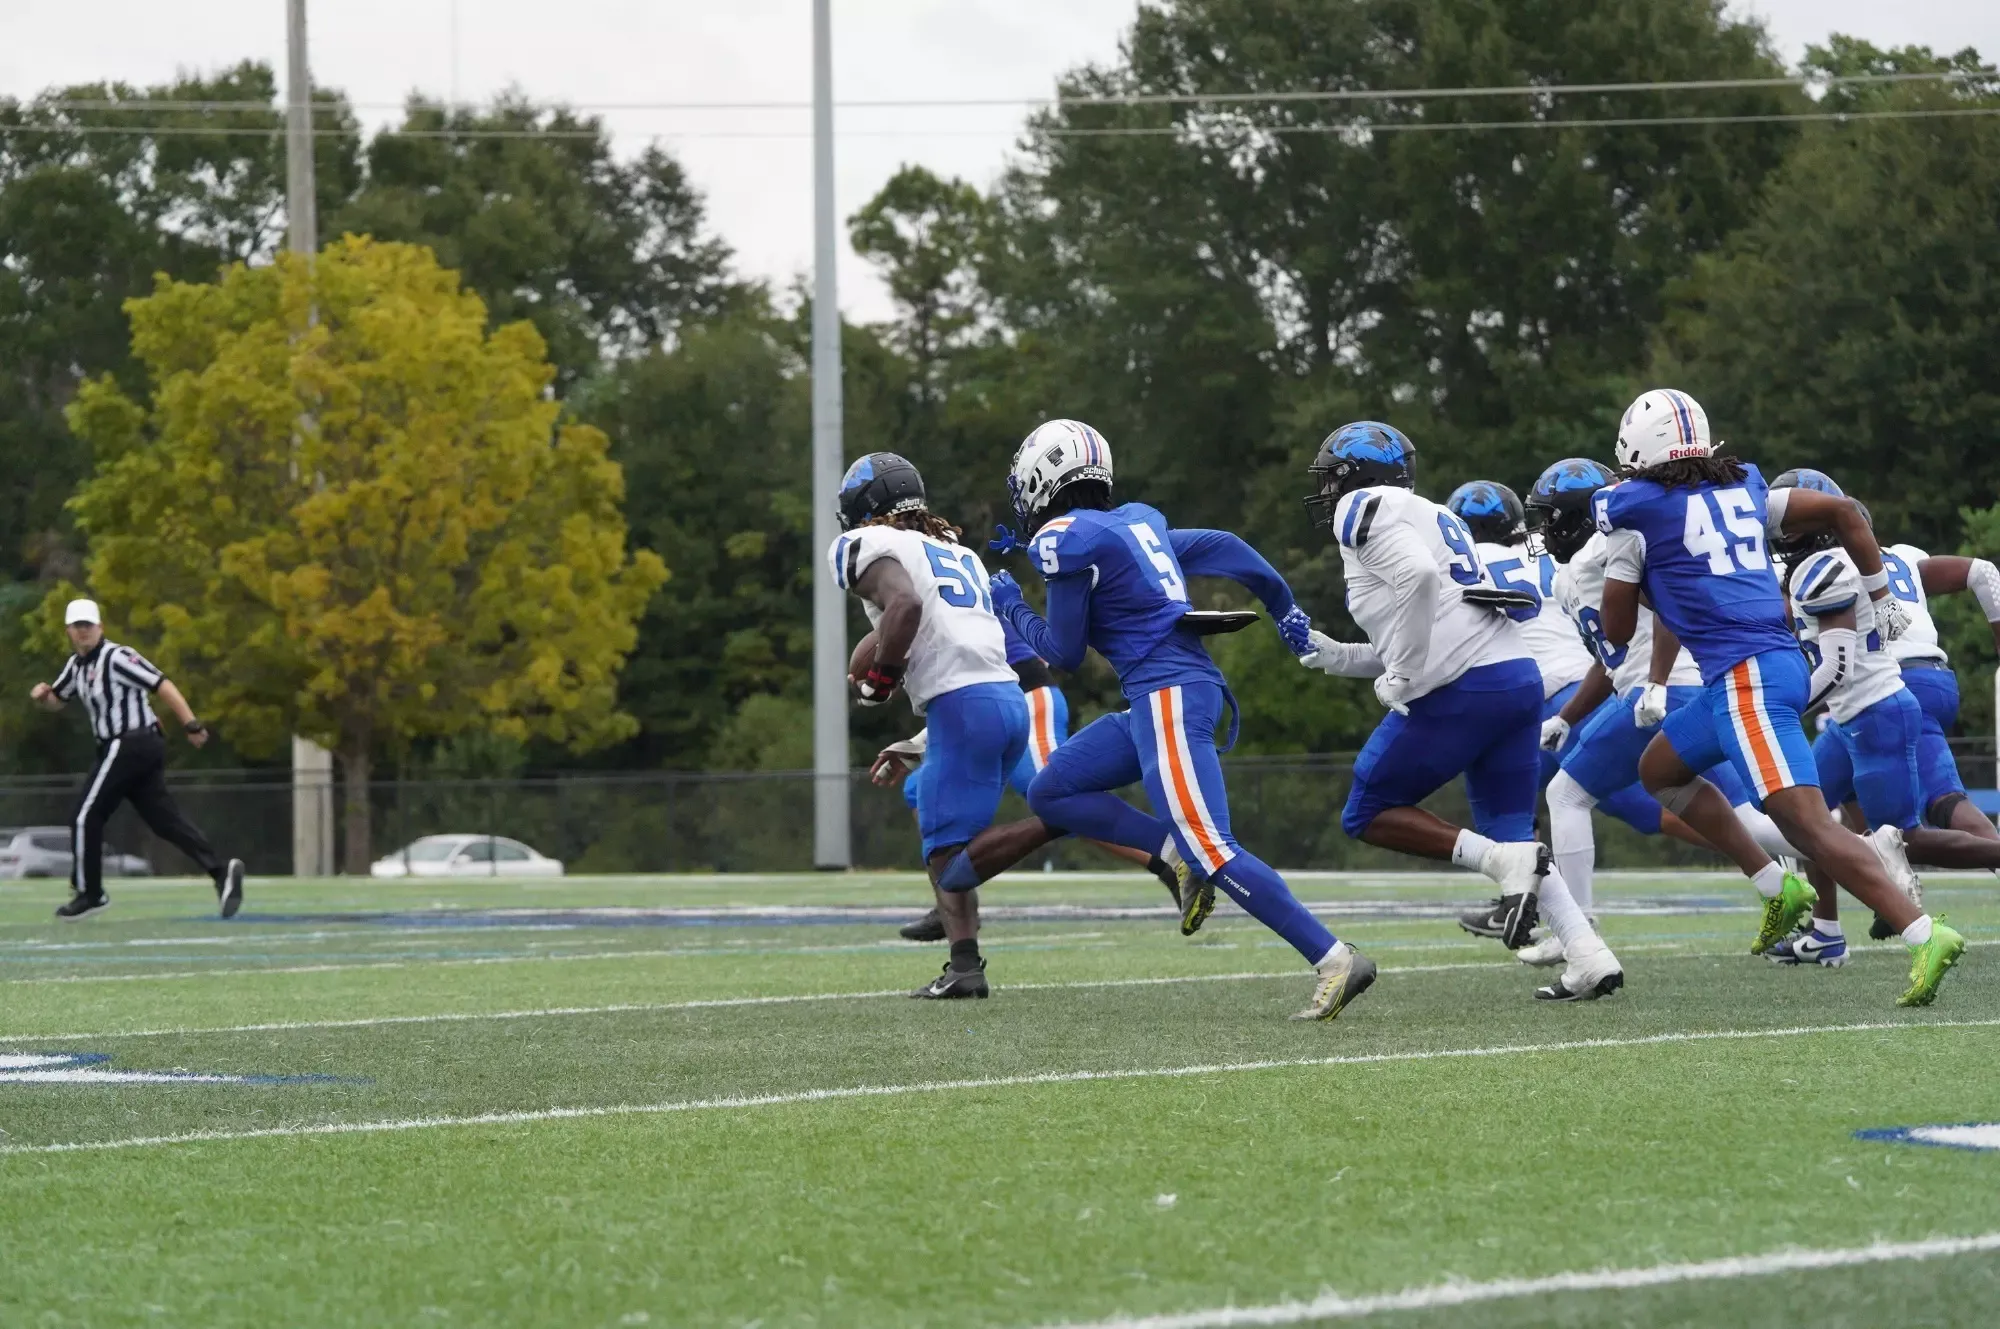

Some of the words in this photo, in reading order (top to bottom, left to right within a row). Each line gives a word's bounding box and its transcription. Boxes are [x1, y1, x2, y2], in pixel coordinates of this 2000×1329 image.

[1669, 446, 1709, 460] Riddell
[1038, 536, 1060, 575] 5
[1127, 522, 1187, 603] 5
[1683, 487, 1768, 576] 45
[921, 540, 992, 614] 51
